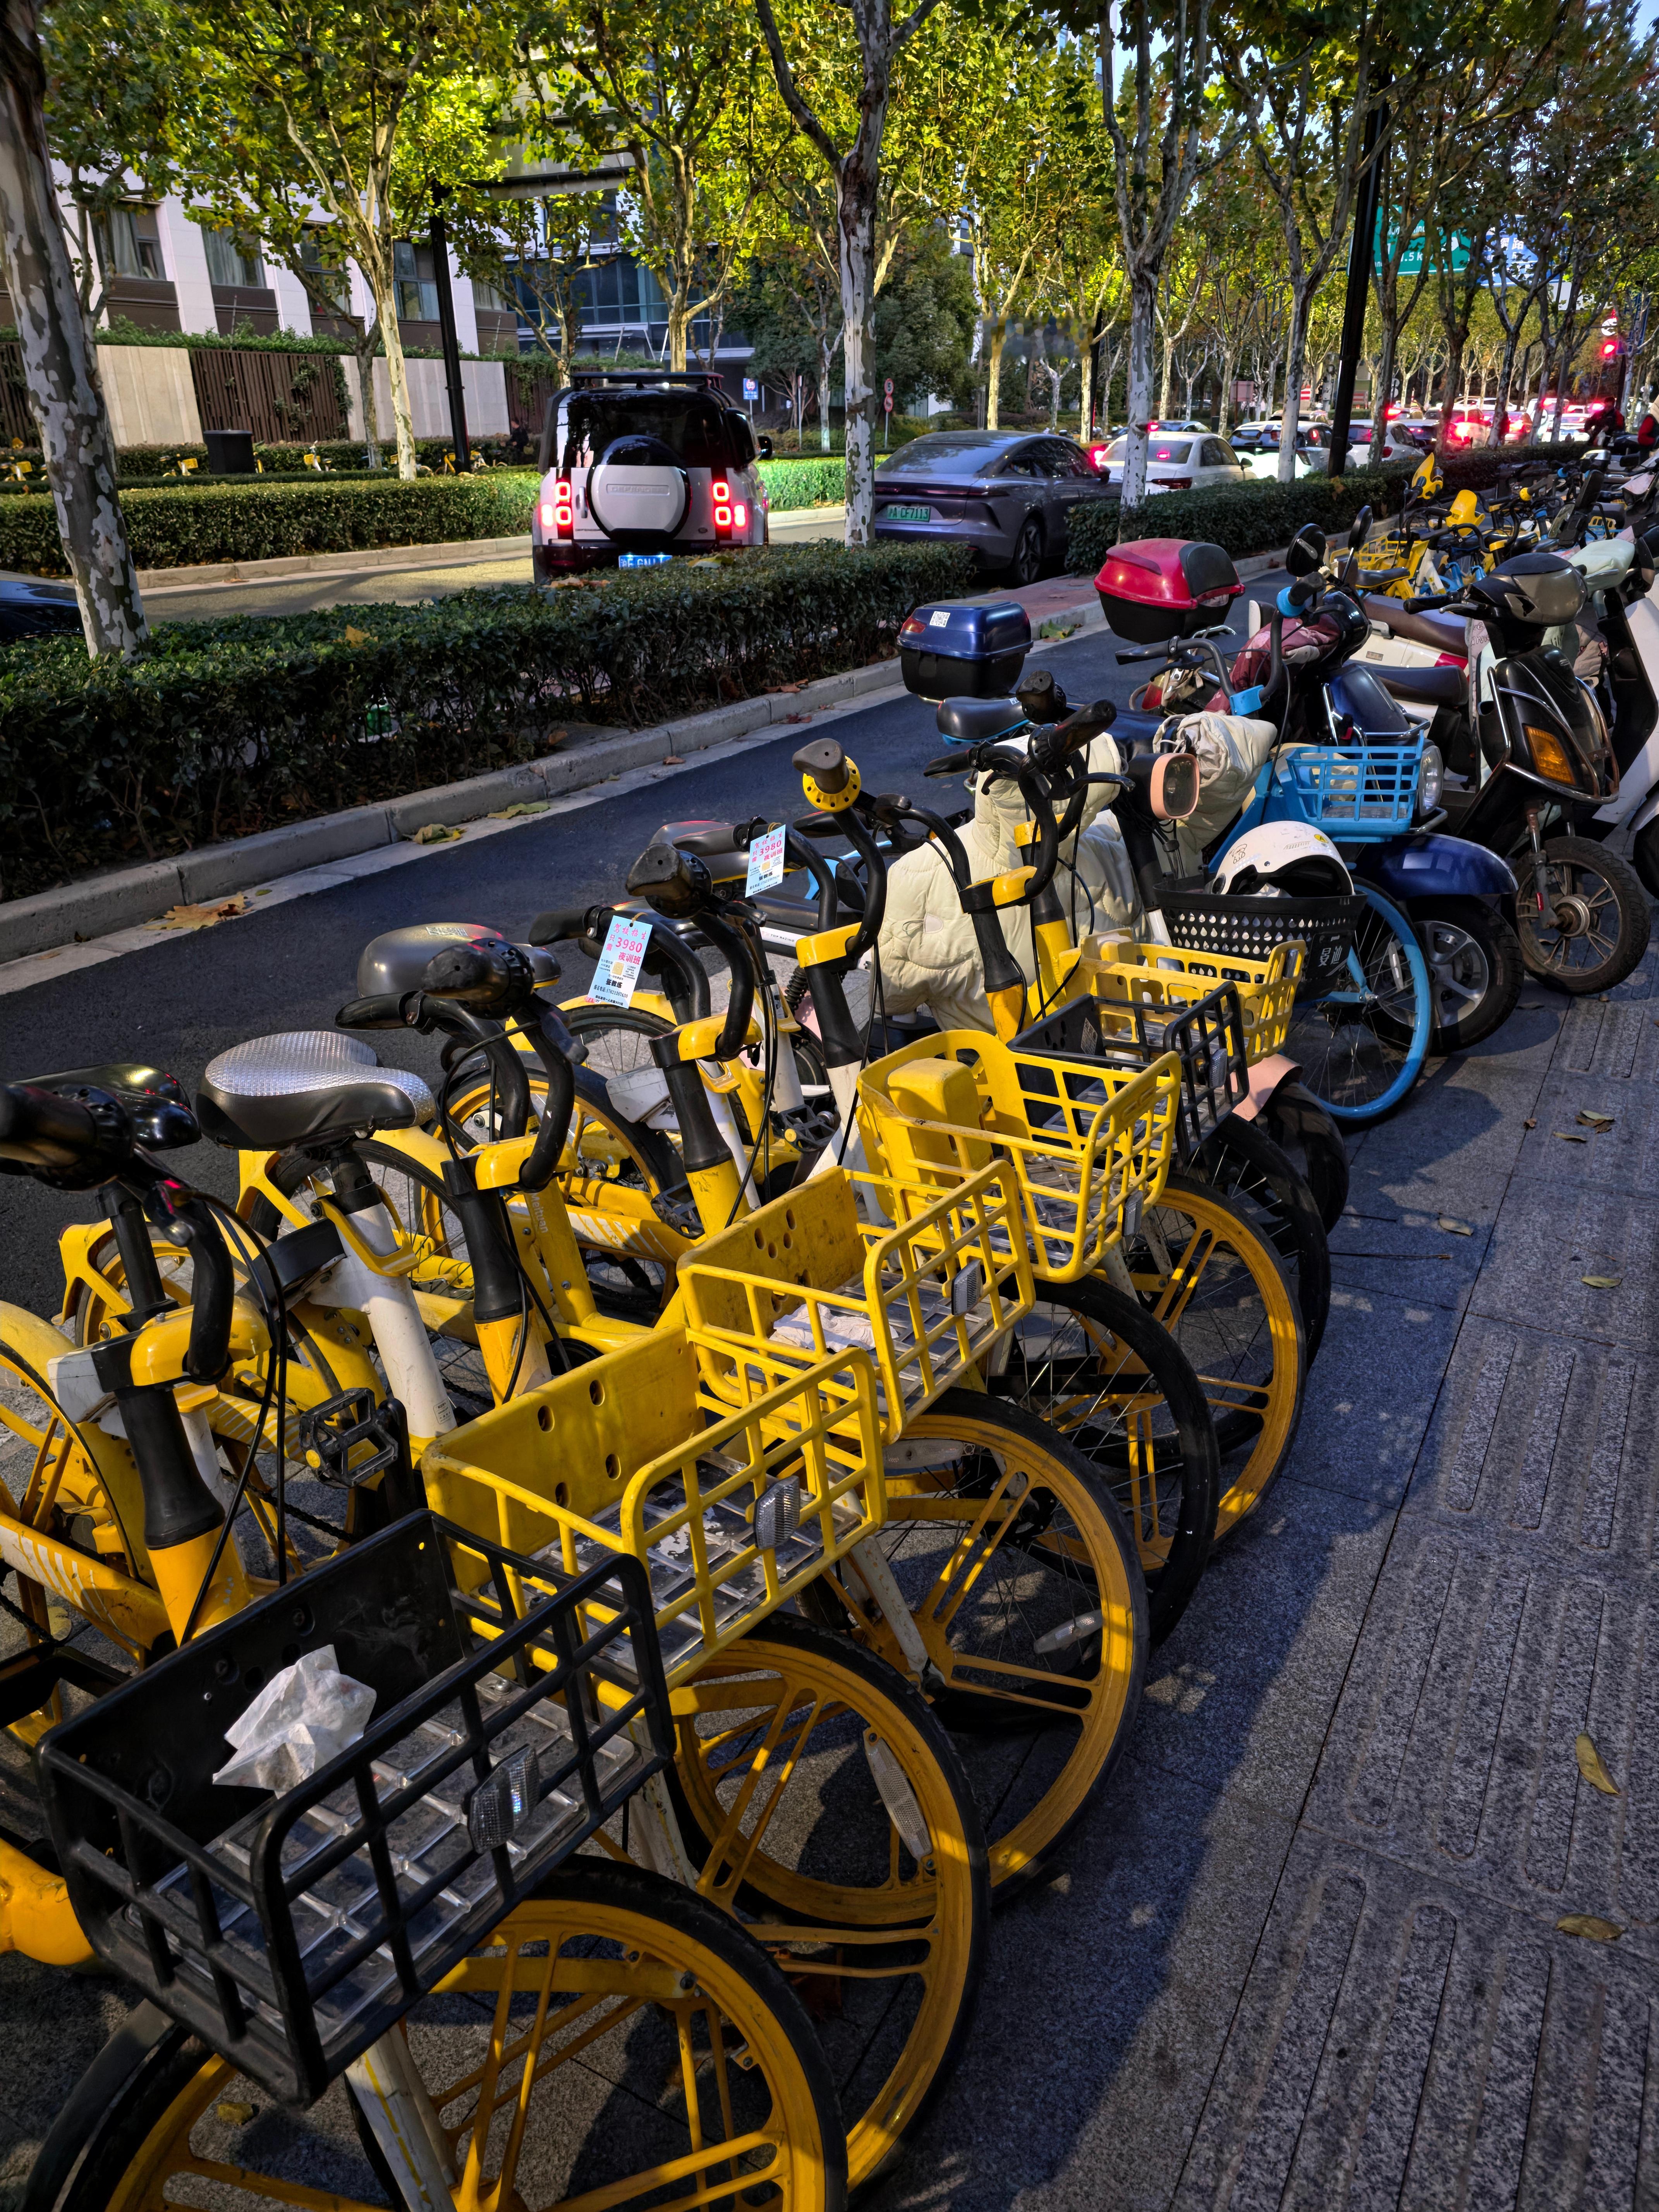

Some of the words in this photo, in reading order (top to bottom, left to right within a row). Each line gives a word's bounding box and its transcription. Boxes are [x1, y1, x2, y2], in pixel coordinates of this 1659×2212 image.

[759, 840, 781, 856] 3980
[615, 937, 642, 953] 3980
[618, 952, 641, 965] 夜训班
[531, 1193, 548, 1233] Meituan
